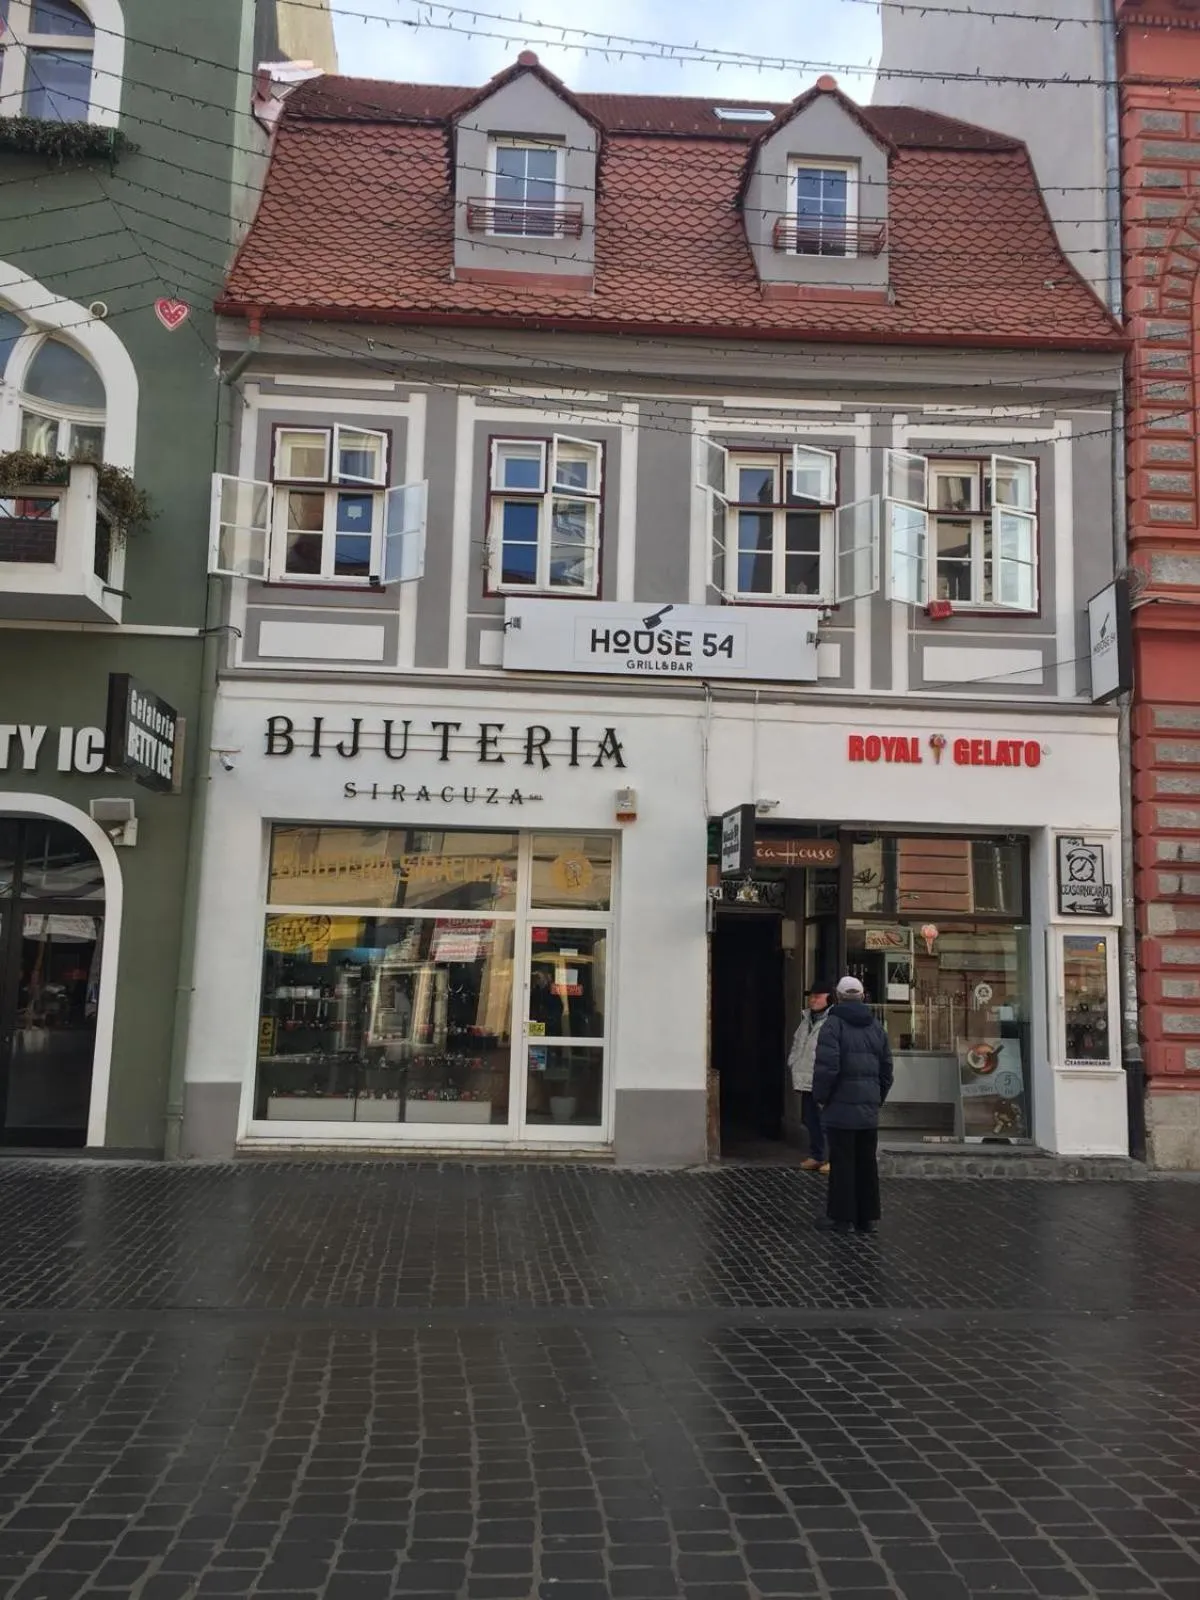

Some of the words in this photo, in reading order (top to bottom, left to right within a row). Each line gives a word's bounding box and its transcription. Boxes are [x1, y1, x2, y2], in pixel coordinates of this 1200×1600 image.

[591, 628, 693, 657] HOUSE
[702, 632, 734, 659] 54
[626, 659, 693, 672] GRILL&BAR
[130, 689, 175, 742] Gelateria
[264, 715, 627, 770] BIJUTERIA
[848, 734, 922, 764] ROYAL
[953, 738, 1041, 768] GELATO
[343, 782, 524, 806] SIRACUZA
[709, 888, 722, 899] 54
